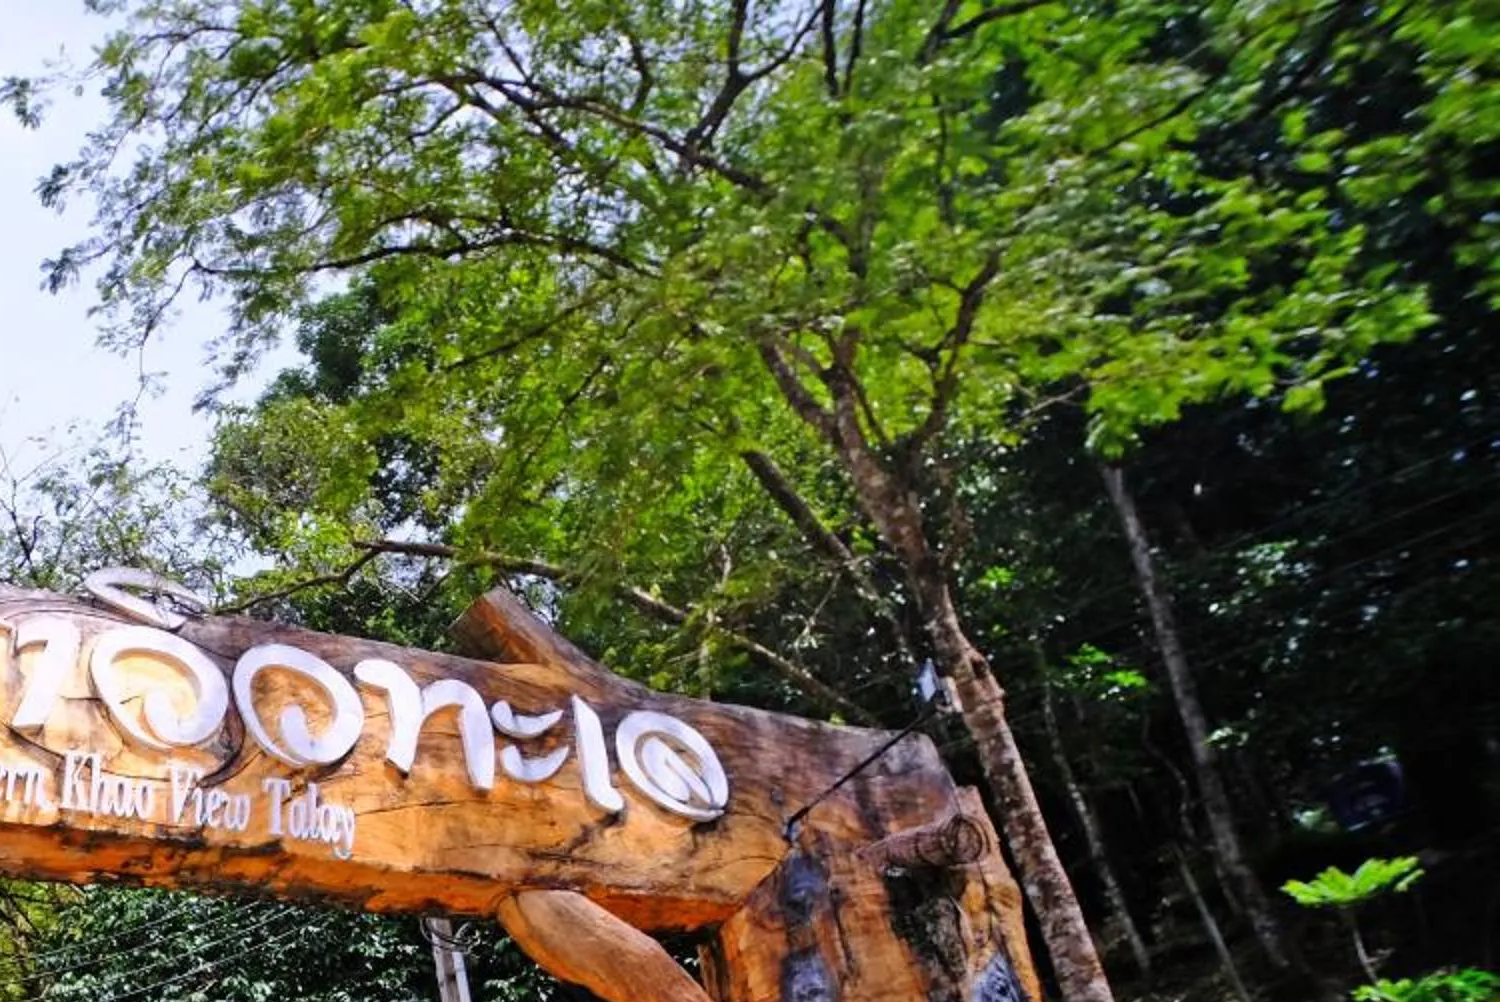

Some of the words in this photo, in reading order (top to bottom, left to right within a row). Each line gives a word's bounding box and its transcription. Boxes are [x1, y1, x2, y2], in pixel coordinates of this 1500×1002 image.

[61, 750, 154, 820] Khao
[167, 764, 252, 832] View
[262, 776, 356, 862] Talay
